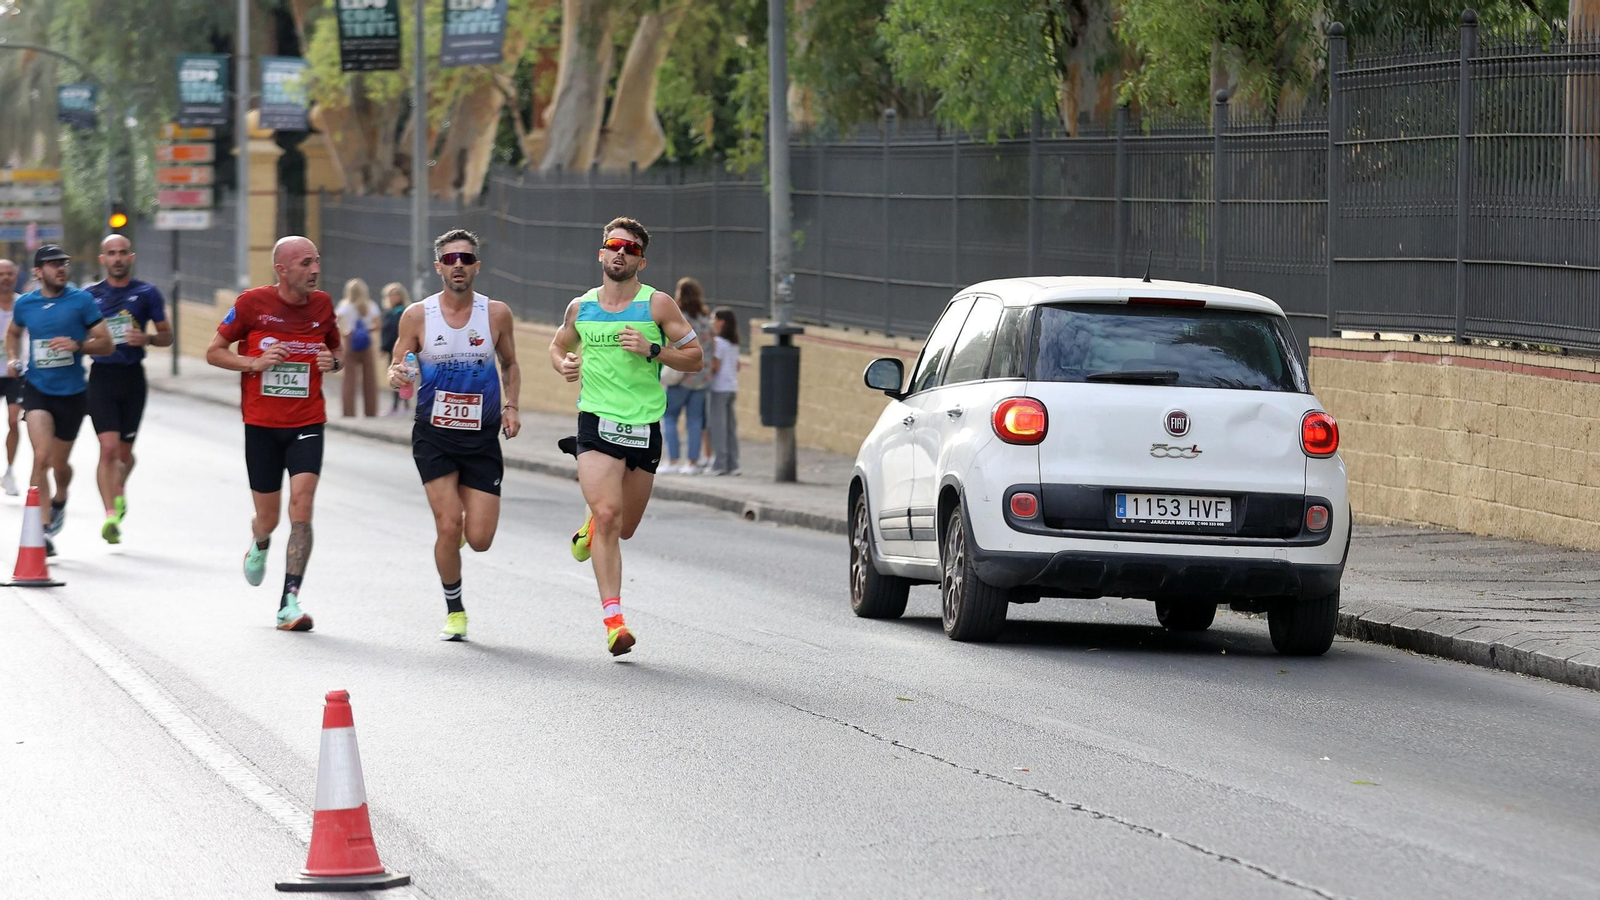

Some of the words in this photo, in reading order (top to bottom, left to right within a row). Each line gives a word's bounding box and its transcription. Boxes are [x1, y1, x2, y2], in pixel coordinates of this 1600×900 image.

[275, 373, 298, 386] 104
[444, 404, 469, 418] 210
[616, 423, 633, 434] 68
[1170, 417, 1186, 430] FIAT
[1133, 498, 1181, 517] 1153
[1188, 499, 1226, 519] HVF
